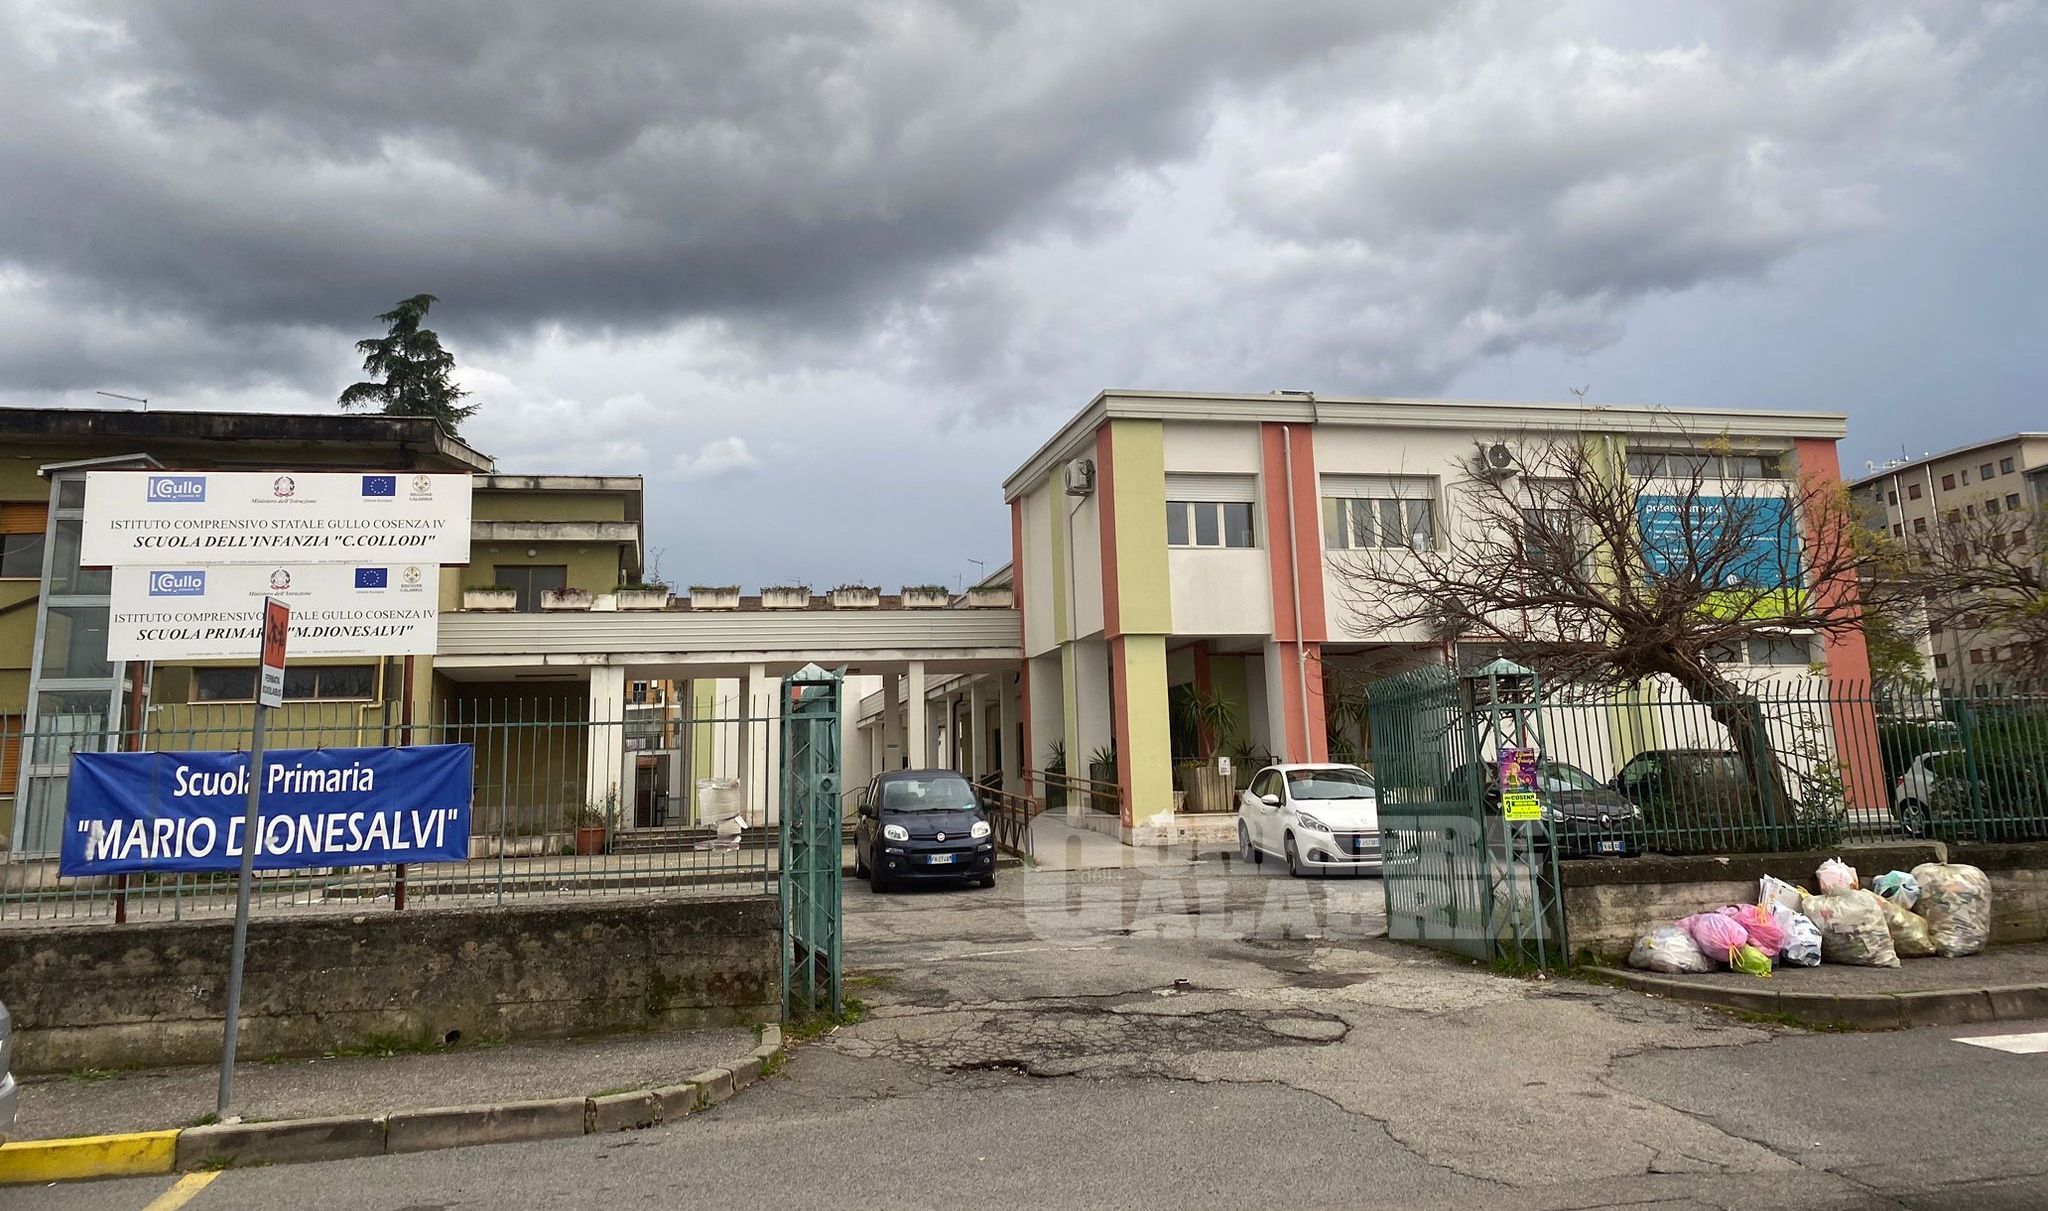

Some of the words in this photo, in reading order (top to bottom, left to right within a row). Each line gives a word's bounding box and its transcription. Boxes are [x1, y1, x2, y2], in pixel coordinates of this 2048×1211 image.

[161, 481, 203, 494] Gullo
[110, 519, 171, 530] ISTITUTO
[174, 519, 268, 530] COMPRENSIVO
[271, 519, 325, 529] STATALE
[328, 519, 370, 529] GULLO
[373, 519, 430, 529] COSENZA
[433, 519, 446, 529] IV
[133, 535, 201, 548] SCUOLA
[204, 535, 329, 548] DELL'INFANZIA
[334, 535, 436, 547] "C.COLLODI"
[162, 575, 202, 588] Gullo
[114, 613, 172, 623] ISTITUTO
[174, 611, 264, 622] COMPRENSIVO
[321, 610, 363, 620] GULLO
[365, 610, 420, 620] COSENZA
[423, 609, 436, 619] IV
[136, 629, 201, 641] SCUOLA
[288, 625, 414, 638] "M.DIONESALVI"
[173, 765, 249, 797] Scuol
[267, 760, 375, 794] Primaria
[1505, 800, 1512, 814] 3
[77, 816, 217, 861] "MARIO
